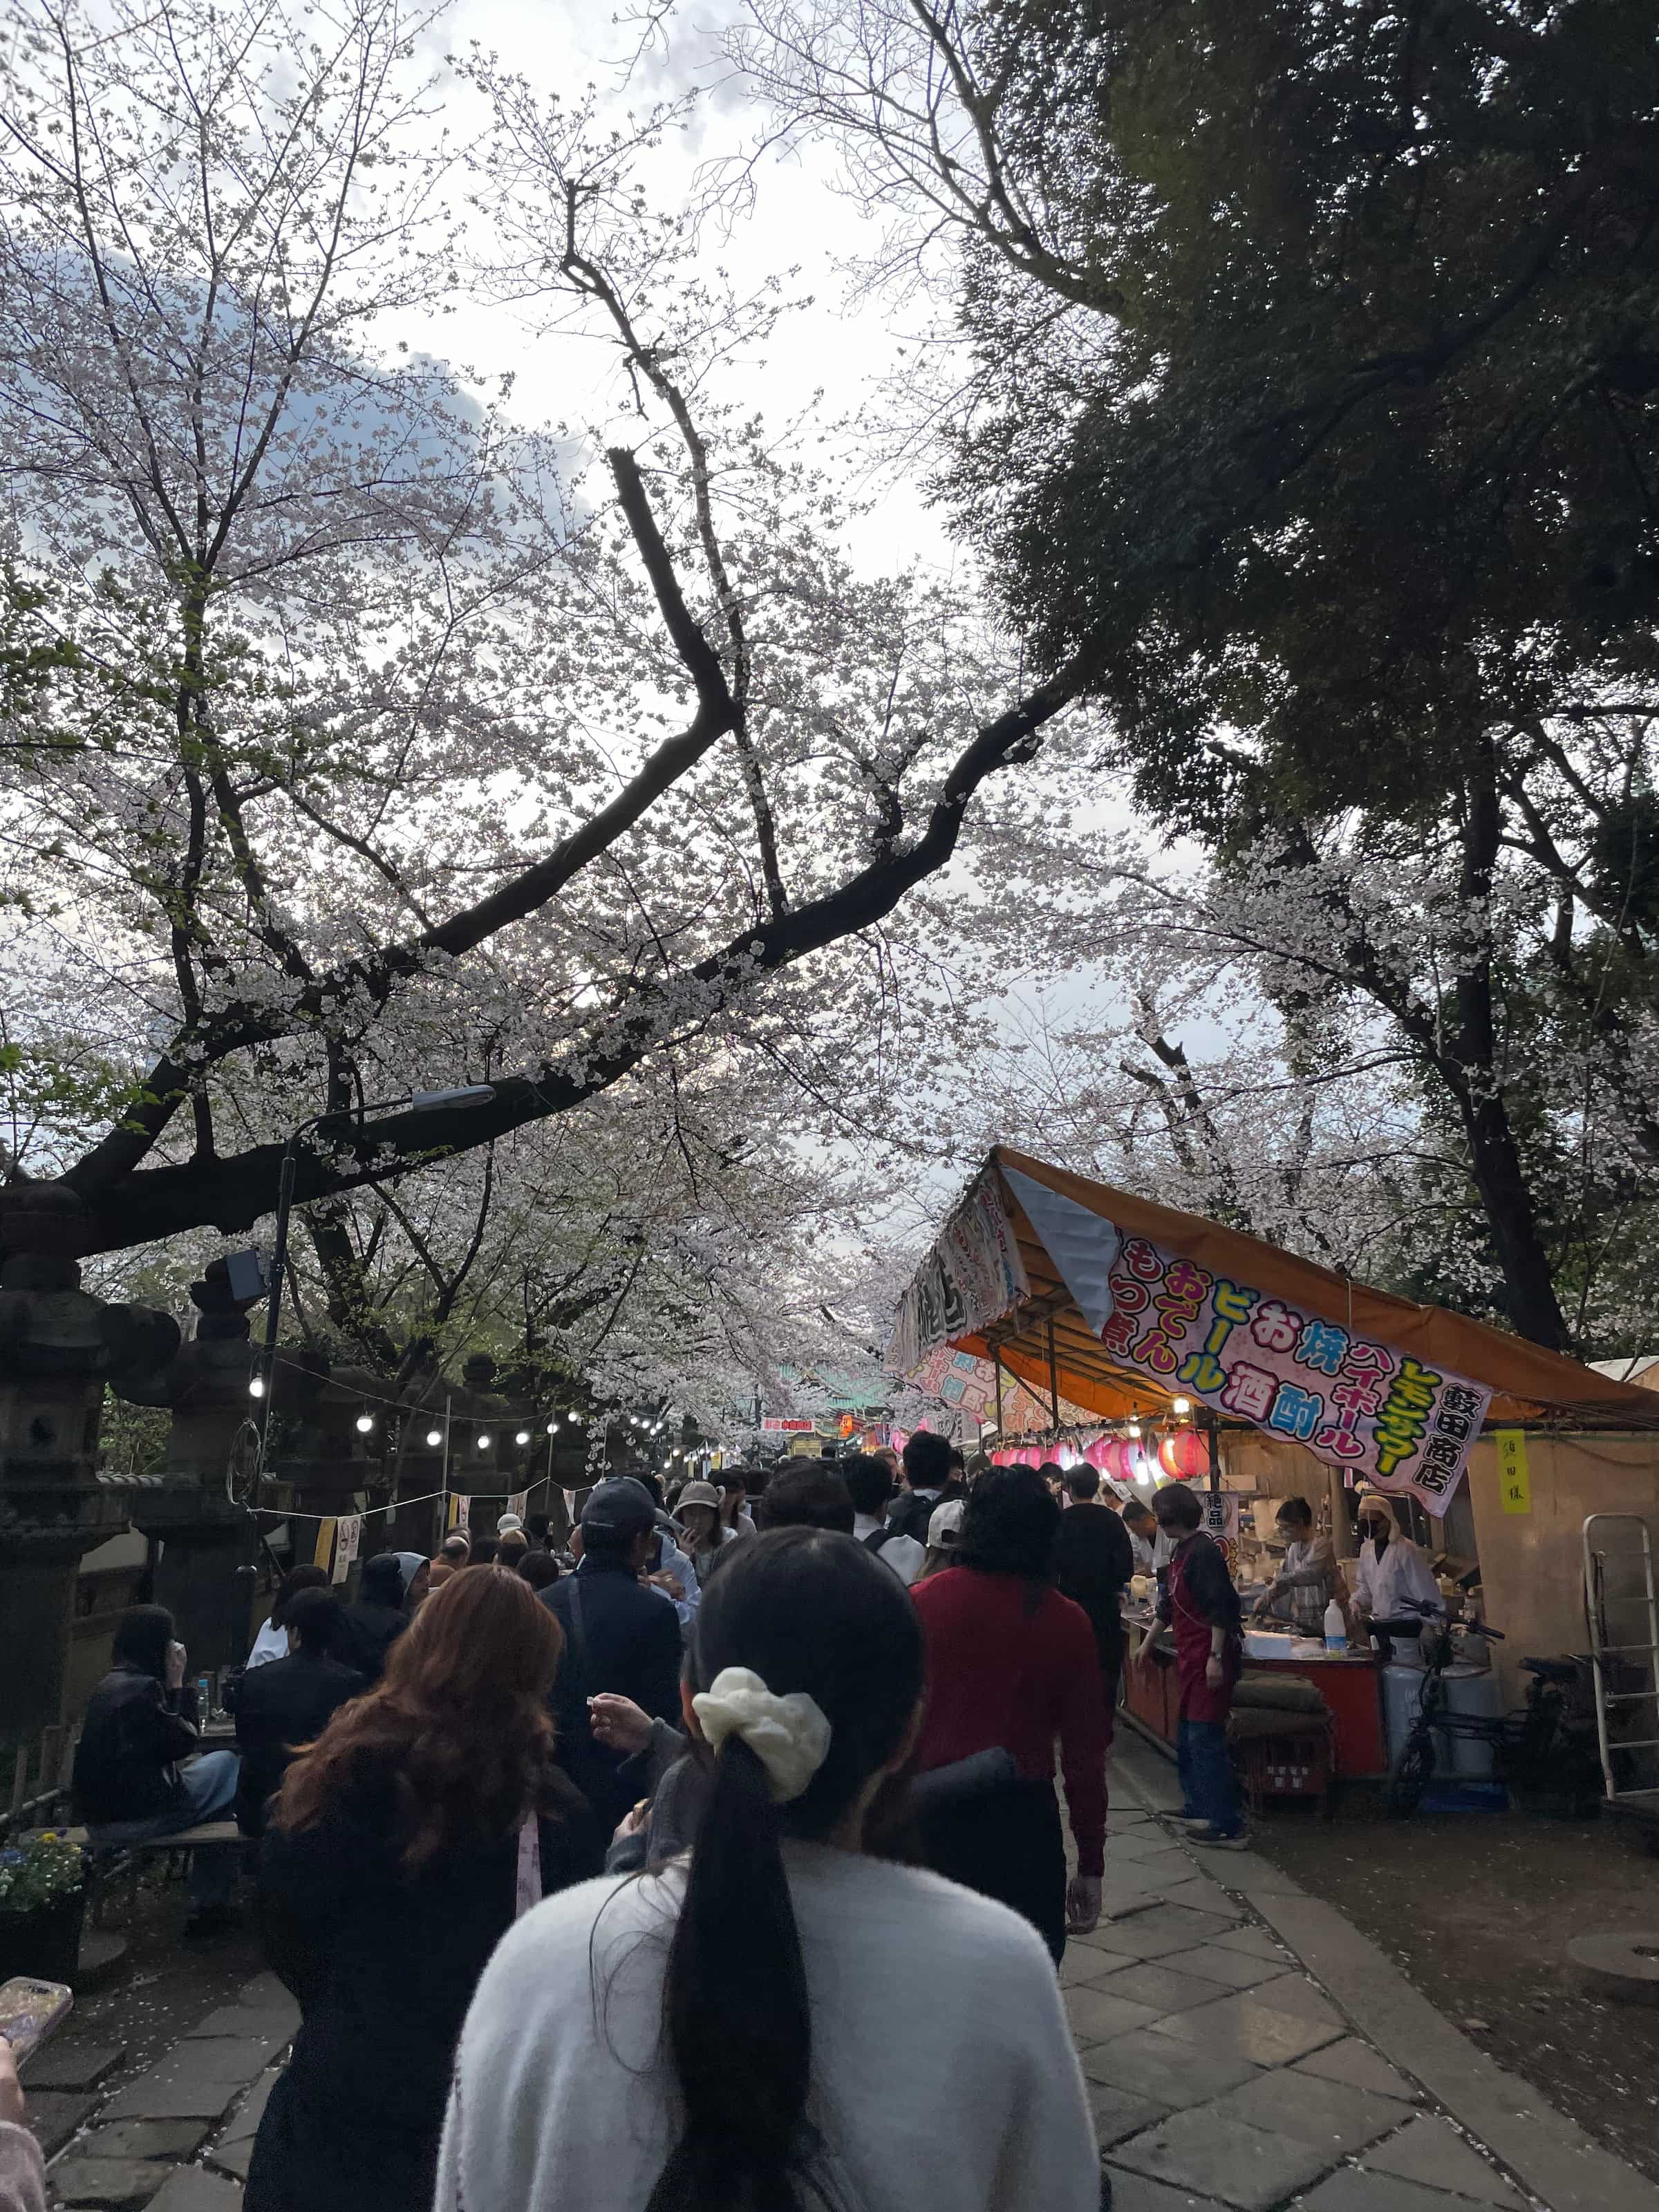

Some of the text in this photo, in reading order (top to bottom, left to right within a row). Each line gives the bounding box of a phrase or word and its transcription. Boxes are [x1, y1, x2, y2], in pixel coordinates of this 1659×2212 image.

[1102, 1238, 1164, 1358] もつ煮
[1132, 1259, 1214, 1374] おでん
[1176, 1280, 1261, 1394] ビール
[1221, 1300, 1304, 1423] お酒
[1268, 1319, 1353, 1441] 焼酎
[1315, 1341, 1395, 1459] ハイボール
[1372, 1357, 1443, 1477] レモンサワー
[1205, 1493, 1224, 1528] 絶品
